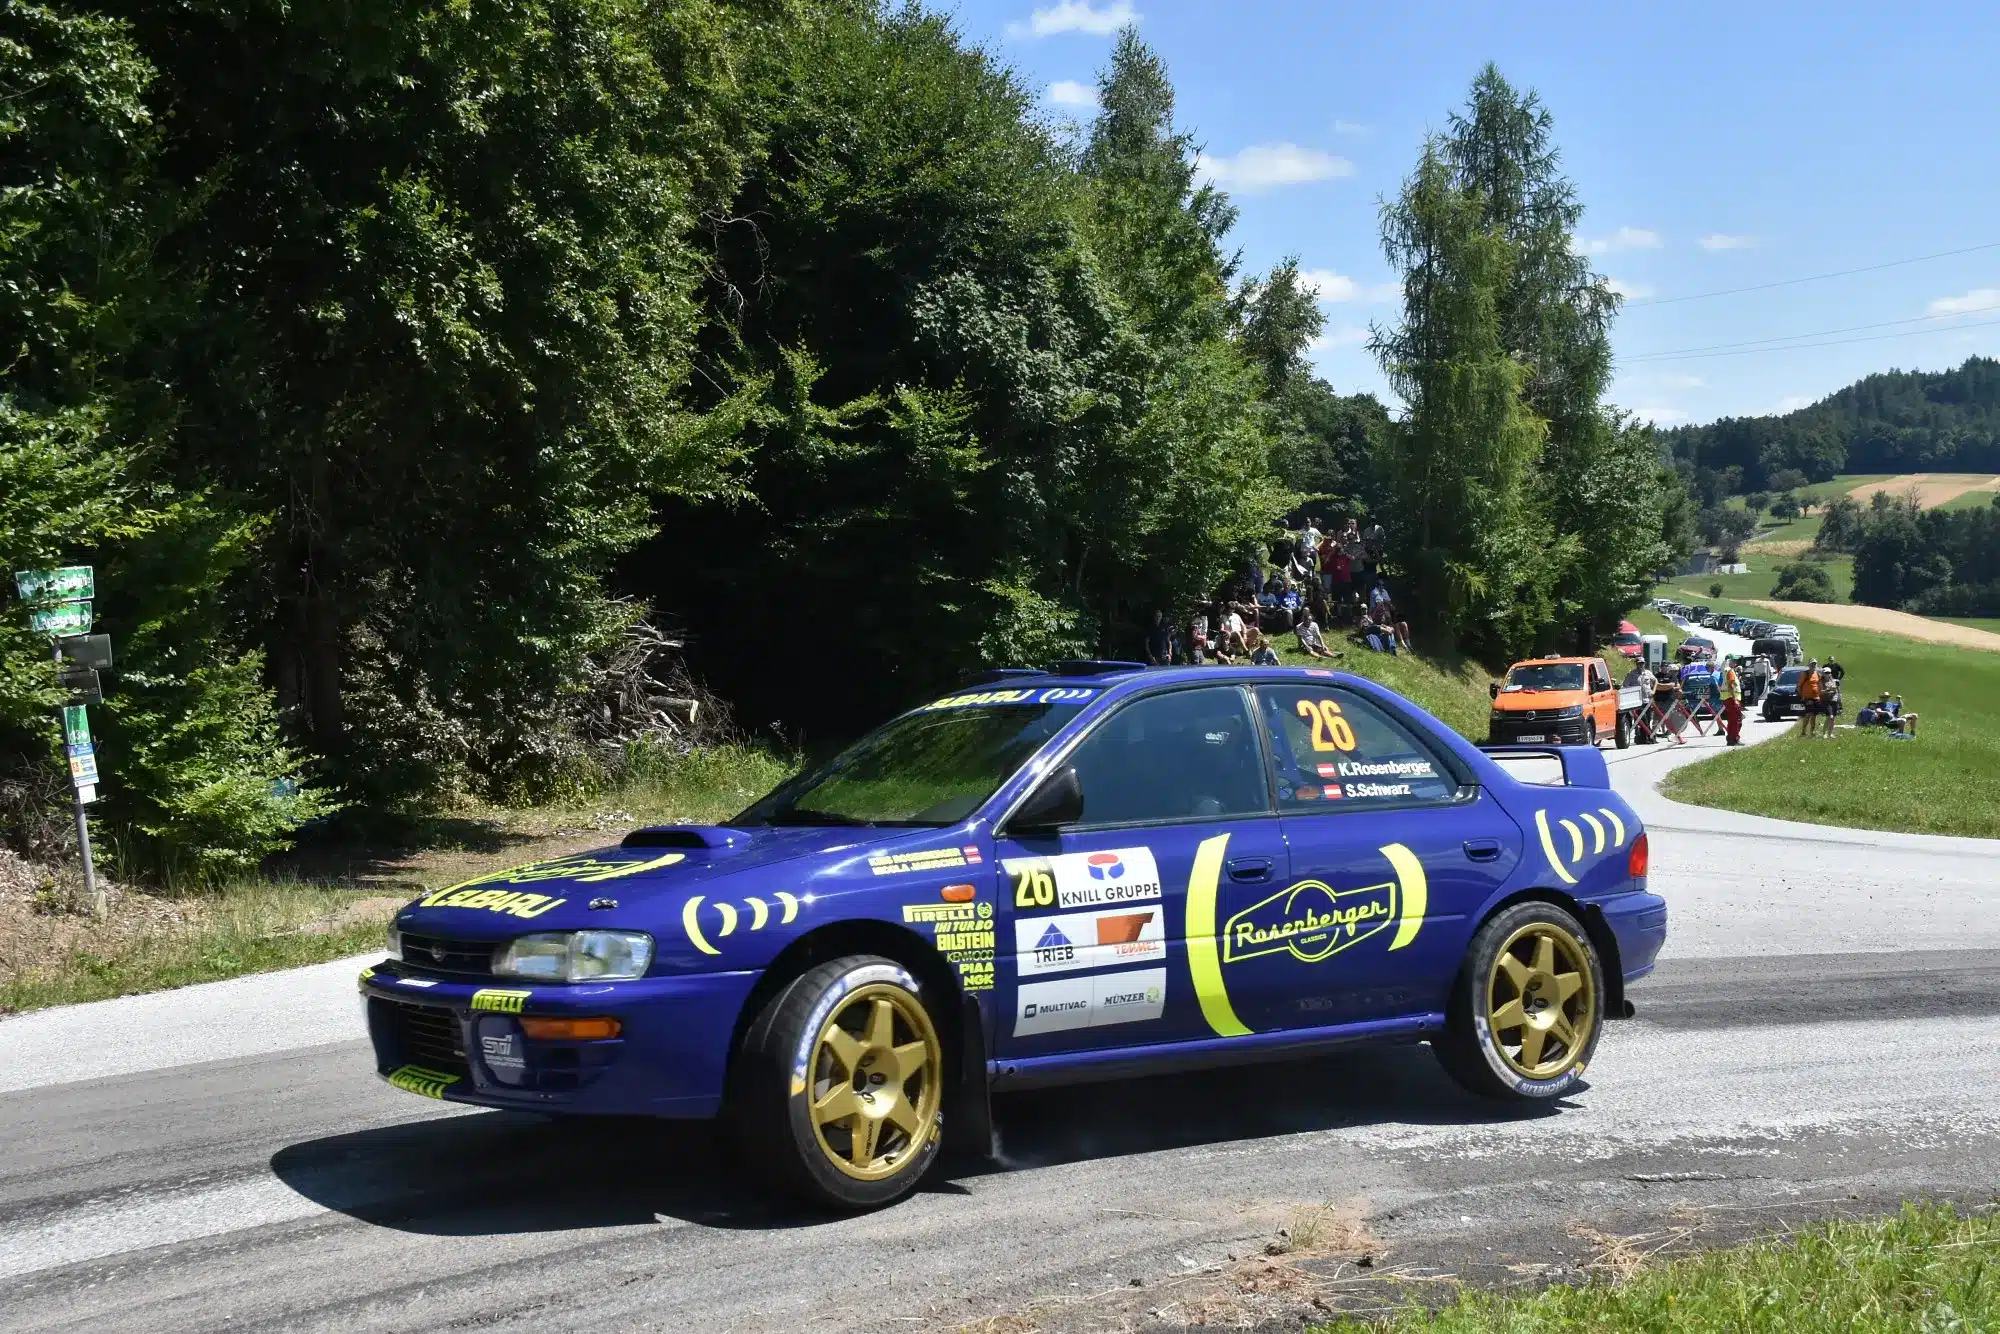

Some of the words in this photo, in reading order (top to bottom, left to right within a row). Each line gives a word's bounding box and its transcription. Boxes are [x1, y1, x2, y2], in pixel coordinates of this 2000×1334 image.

[924, 688, 1036, 710] SUBARU
[1297, 700, 1355, 751] 26
[1338, 761, 1431, 776] K.Rosenberger
[1346, 783, 1411, 797] S.Schwarz
[1015, 864, 1054, 908] 26
[1062, 887, 1101, 905] KNILL
[1105, 882, 1159, 900] GRUPPE
[437, 890, 567, 918] SUBARU
[903, 903, 975, 923] PIRELLI
[934, 922, 952, 933] IHI
[953, 920, 994, 931] TURBO
[1236, 900, 1388, 947] Rosenberger
[937, 932, 994, 951] BILSTEIN
[1300, 934, 1327, 944] CLASSICS
[946, 950, 994, 962] KENWOOD
[1034, 946, 1074, 963] TRIEB
[959, 962, 994, 974] PIAA
[964, 974, 994, 986] NGK
[471, 989, 532, 1013] PIRELLI
[1039, 1000, 1087, 1014] MULTIVAC
[1104, 992, 1145, 1006] MÜNZER
[1520, 1076, 1568, 1094] MICHELIN
